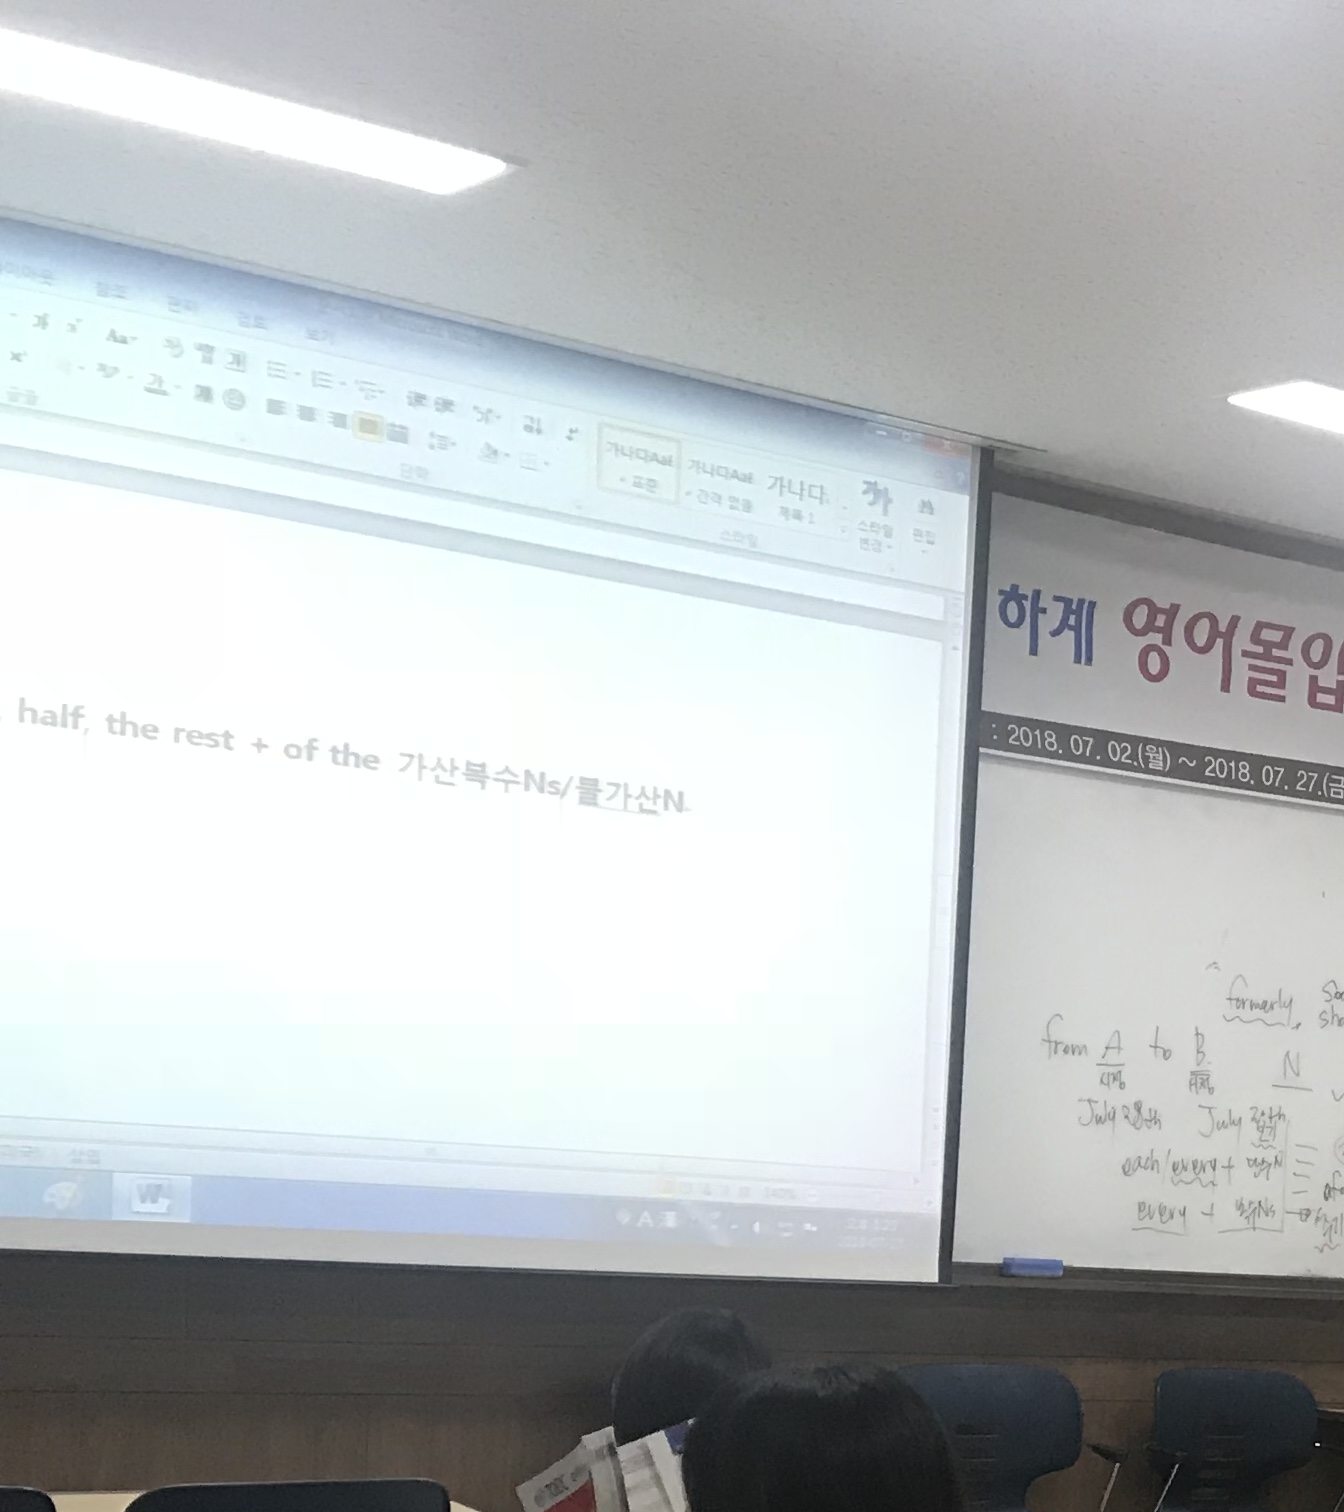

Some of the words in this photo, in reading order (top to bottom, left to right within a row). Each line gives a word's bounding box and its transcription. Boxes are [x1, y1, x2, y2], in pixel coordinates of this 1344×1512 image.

[997, 583, 1097, 667] 하계
[18, 697, 90, 737] half,
[104, 710, 160, 741] the
[172, 726, 235, 752] rest
[283, 738, 319, 762] of
[329, 742, 381, 772] the
[1006, 724, 1064, 754] 2018.
[1070, 734, 1102, 760] 07.
[1107, 740, 1171, 773] 02.(월)
[1204, 756, 1256, 785] 2018.
[1261, 765, 1289, 791] 07.
[1041, 1013, 1088, 1060] from
[1101, 1029, 1123, 1058] A
[1149, 1026, 1172, 1061] to
[1283, 1050, 1301, 1080] N
[1077, 1098, 1117, 1136] July
[1198, 1103, 1243, 1142] July
